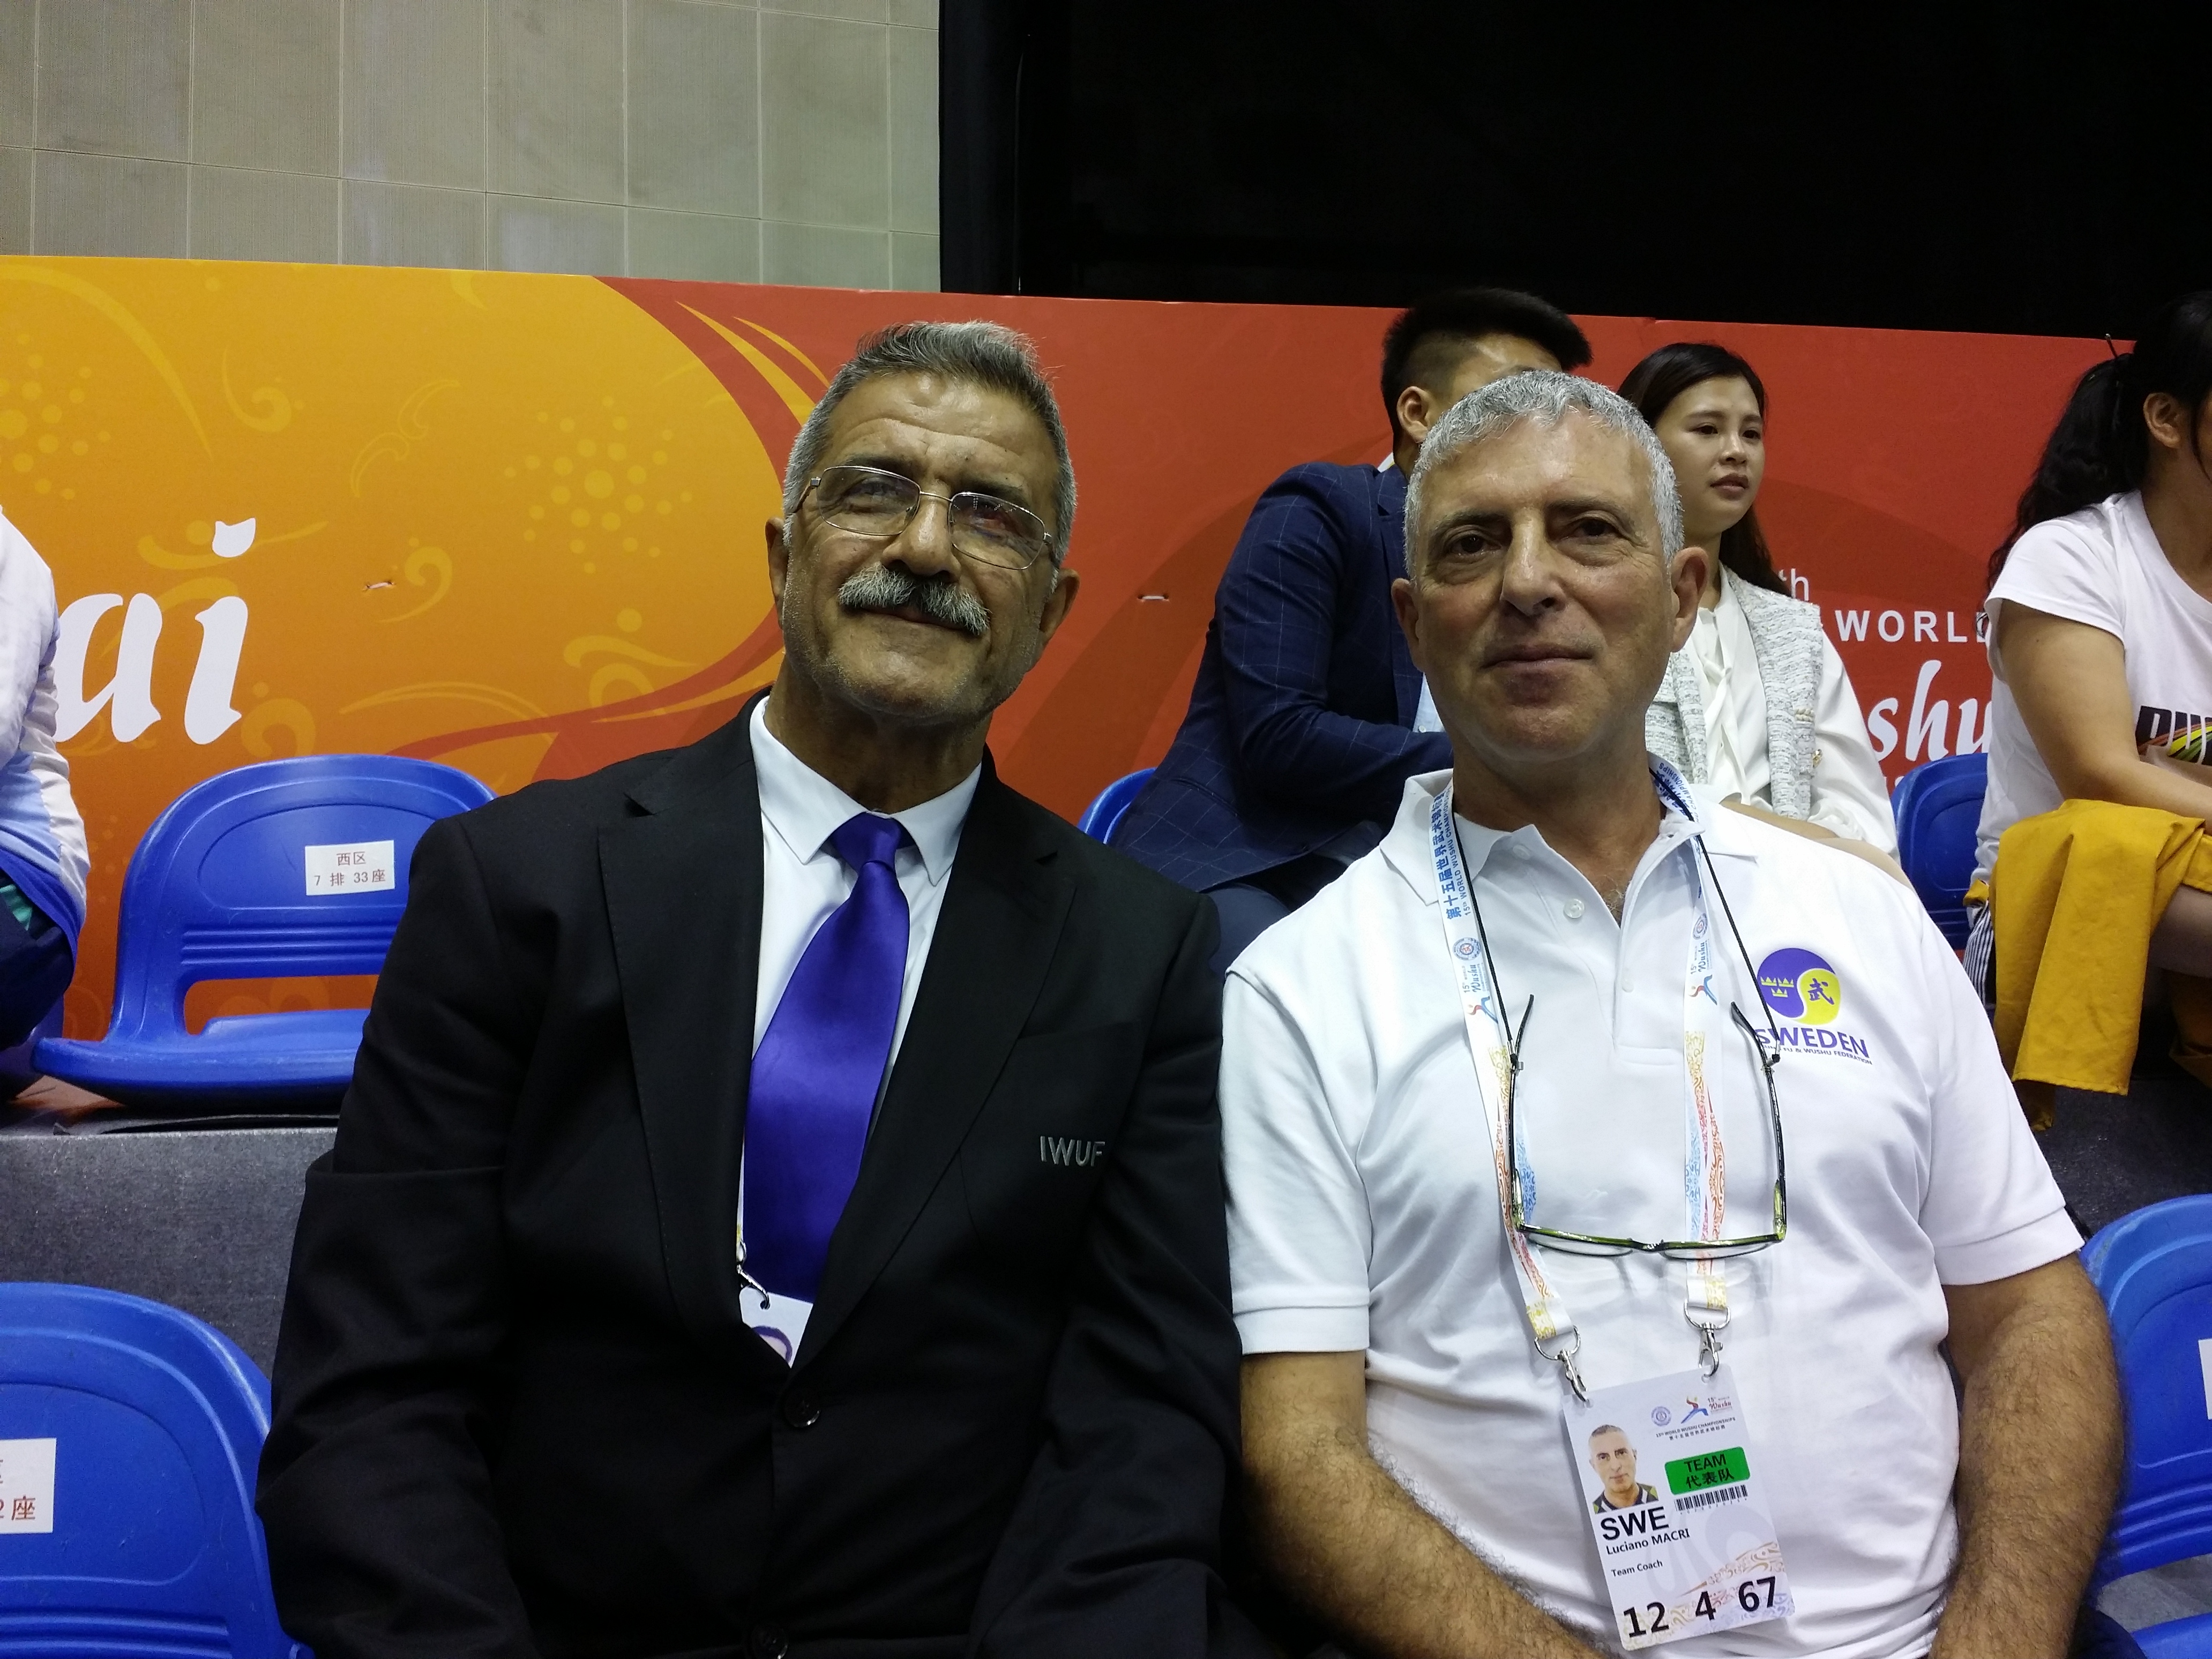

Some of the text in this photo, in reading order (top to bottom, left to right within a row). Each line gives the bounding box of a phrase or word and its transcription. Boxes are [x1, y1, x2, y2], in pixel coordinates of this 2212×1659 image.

[336, 851, 367, 866] 西区
[1447, 839, 1459, 869] WUSHU
[314, 875, 321, 886] 7
[330, 872, 345, 886] 排
[1454, 870, 1467, 900] WORLD
[1807, 978, 1835, 1005] 武
[1755, 1027, 1870, 1058] SWEDEN
[1834, 1051, 1873, 1065] FEDERATION
[1040, 1135, 1105, 1167] IWUF
[1664, 1428, 1680, 1437] WORLD
[1680, 1425, 1698, 1433] WUSHU
[1698, 1417, 1736, 1429] CHAMPIONSHIPS
[1684, 1453, 1727, 1473] TEAM
[1686, 1468, 1735, 1489] 代表队
[1600, 1506, 1669, 1541] SWE
[1606, 1528, 1690, 1555] Luciano MACRI
[1611, 1559, 1663, 1577] Team Coach
[1623, 1576, 1776, 1638] 12 4 67
